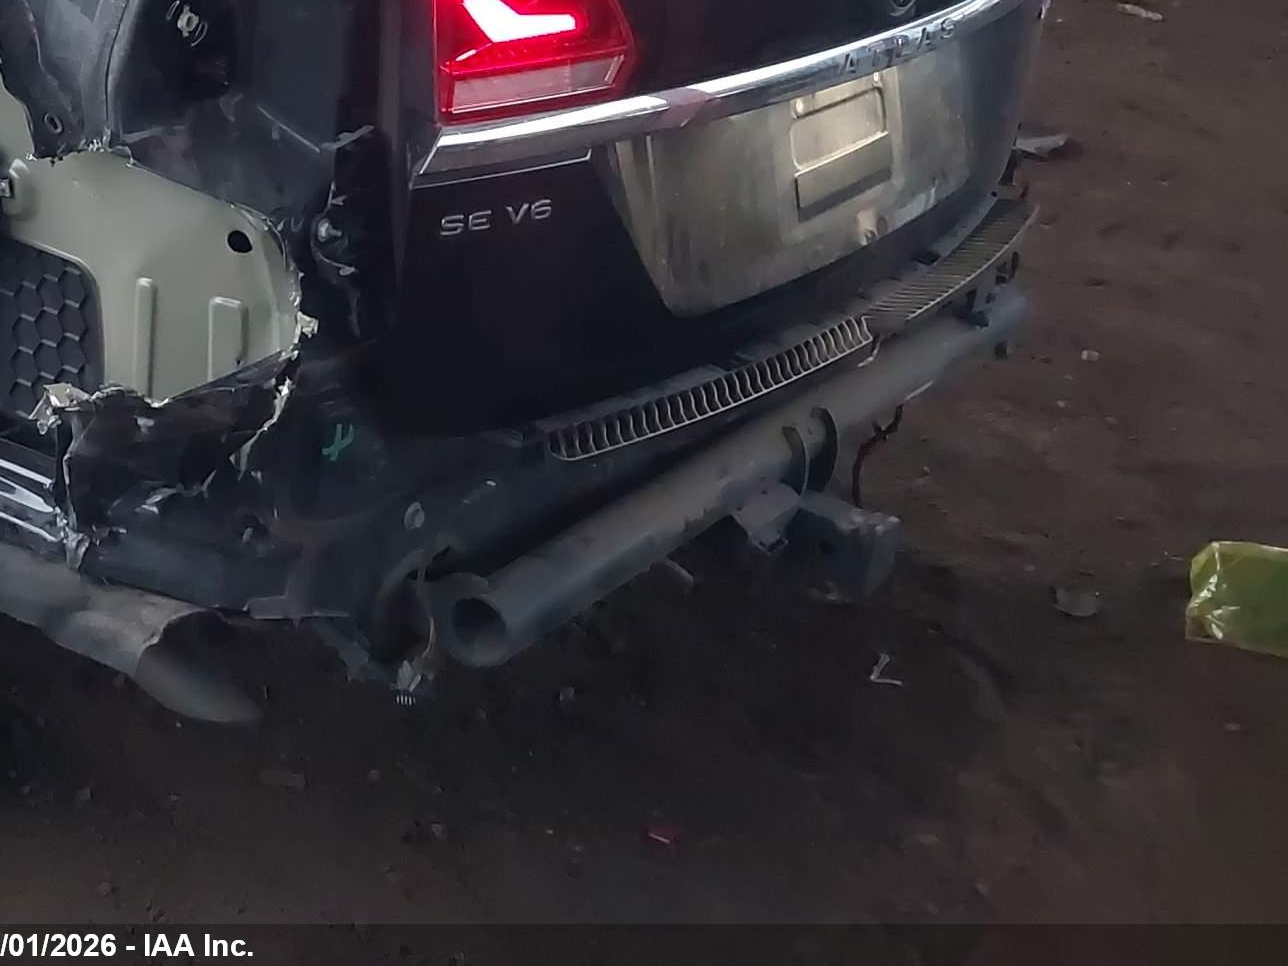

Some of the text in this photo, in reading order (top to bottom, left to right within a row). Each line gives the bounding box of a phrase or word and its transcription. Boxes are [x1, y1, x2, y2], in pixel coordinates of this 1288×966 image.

[838, 17, 956, 76] ATLAS
[440, 199, 552, 235] SE V6
